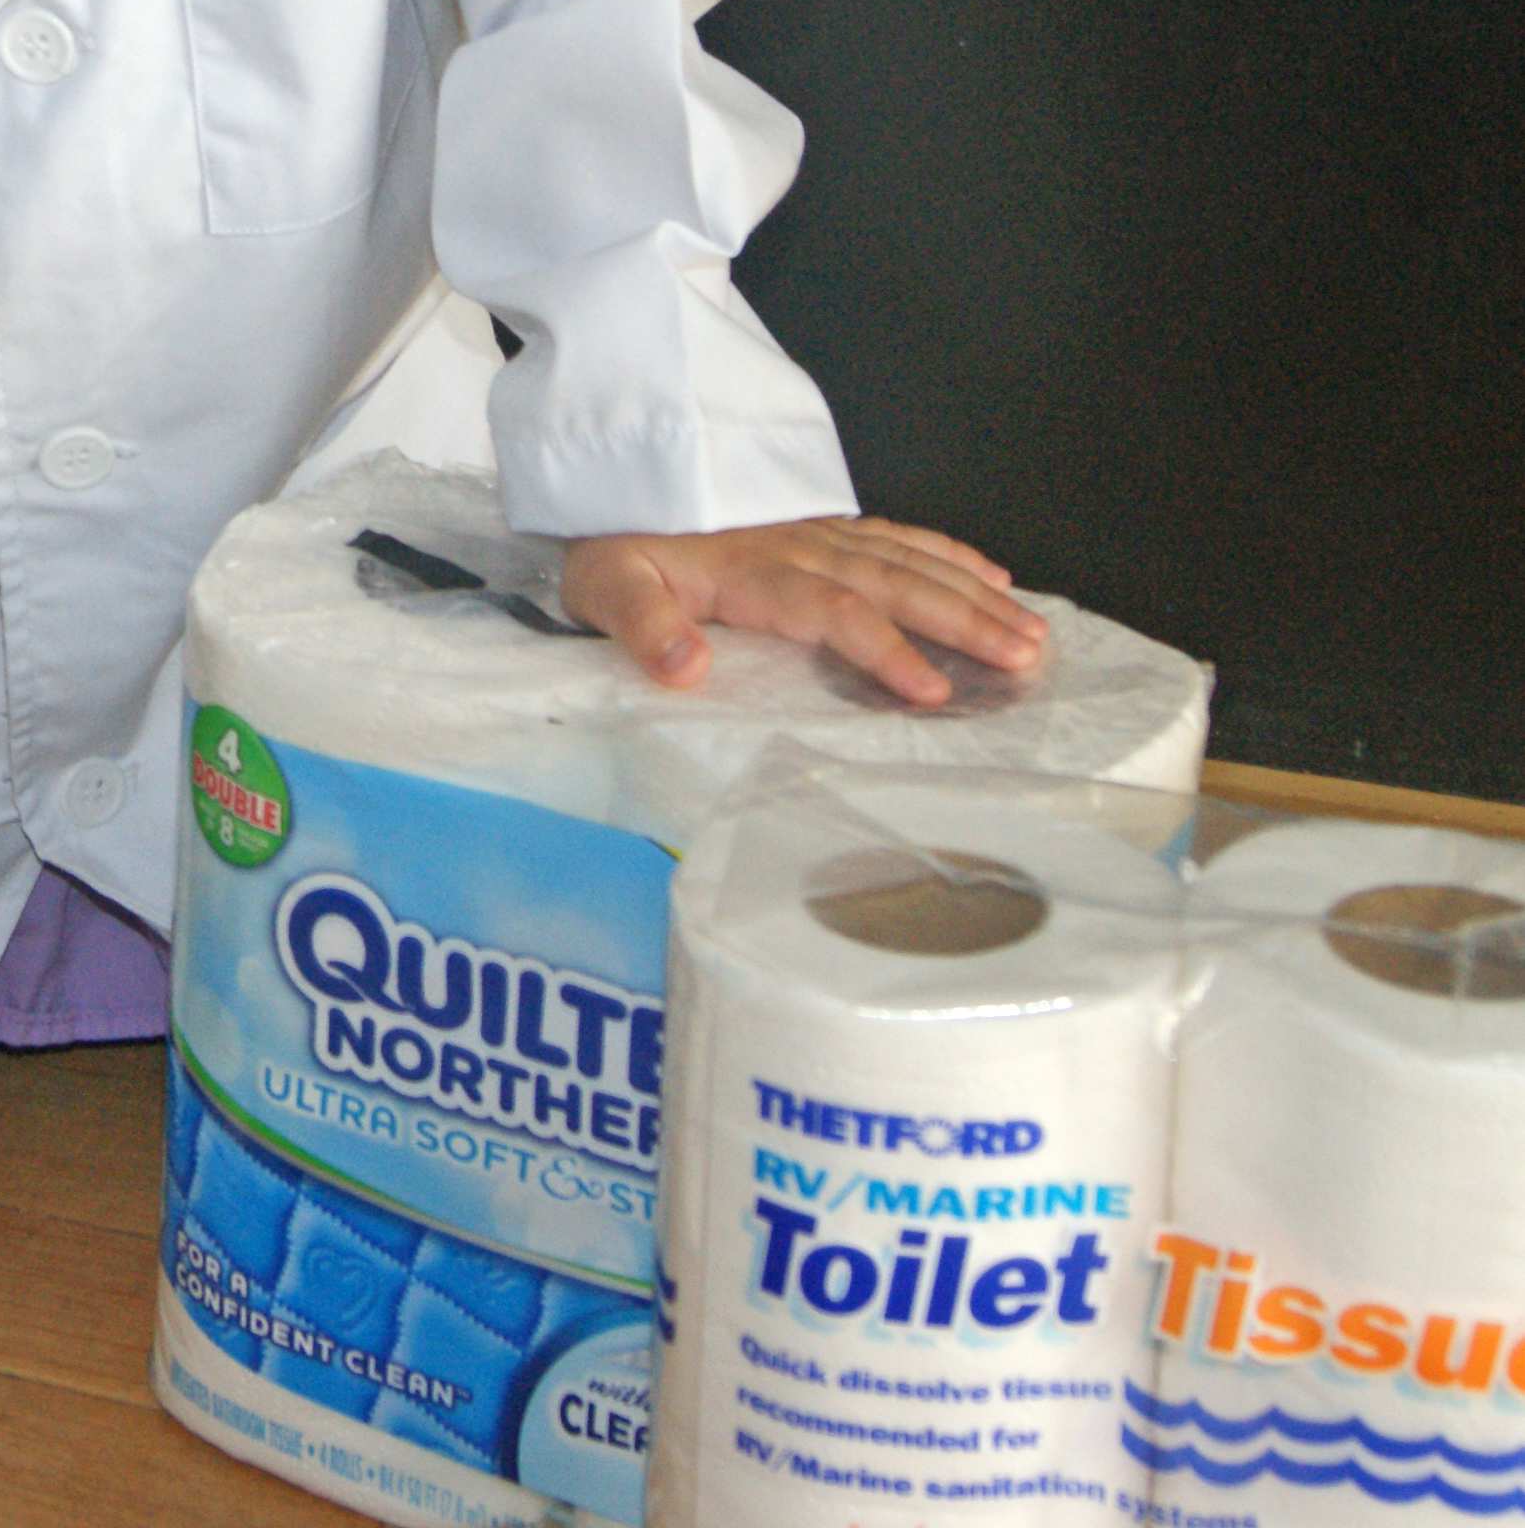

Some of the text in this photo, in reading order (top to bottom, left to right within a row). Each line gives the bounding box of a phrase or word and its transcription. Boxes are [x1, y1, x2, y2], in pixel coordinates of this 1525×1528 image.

[218, 729, 241, 774] 4
[192, 752, 279, 832] DOUBLE
[219, 815, 234, 847] 8
[263, 1066, 398, 1137] ULTRA
[415, 1118, 536, 1183] SOFT
[751, 1079, 1045, 1157] THETFORD
[753, 1147, 1132, 1219] RV/MARINE
[175, 1229, 248, 1298] FOR A
[755, 1196, 1107, 1329] Toilet
[175, 1262, 335, 1364] CONFIDENT
[1156, 1233, 1525, 1395] Tissu
[740, 1335, 1113, 1402] Quick dissolve tissue
[737, 1386, 1042, 1451] recommended for
[735, 1427, 913, 1496] RV/Marine
[925, 1474, 1106, 1501] sanitation
